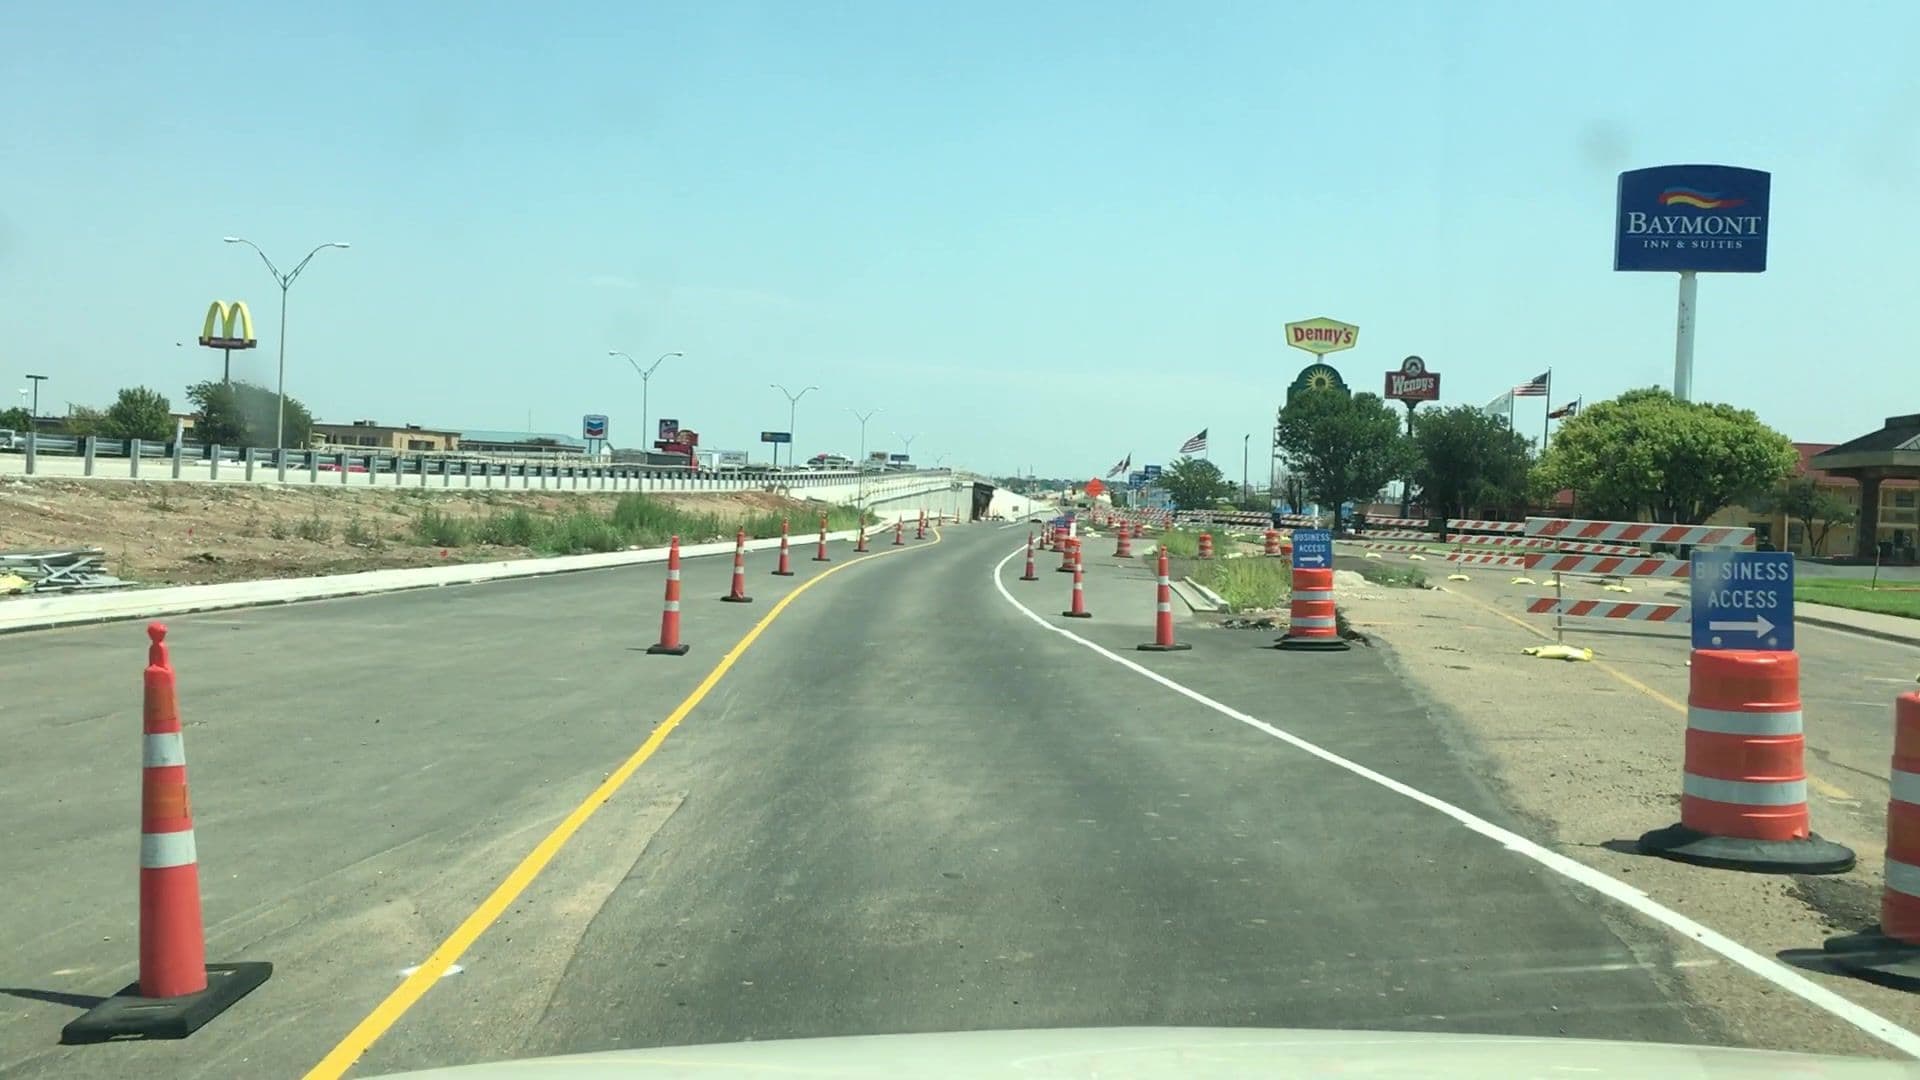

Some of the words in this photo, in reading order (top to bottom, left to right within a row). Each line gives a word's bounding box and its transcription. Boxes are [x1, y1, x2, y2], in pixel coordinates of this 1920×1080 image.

[1643, 239, 1669, 249] INN
[1676, 239, 1685, 249] &
[1691, 240, 1743, 249] SUITES
[1293, 326, 1353, 345] Denny's
[1392, 375, 1435, 395] Wendy's
[1299, 544, 1326, 552] ACCESS
[1708, 590, 1778, 608] ACCESS
